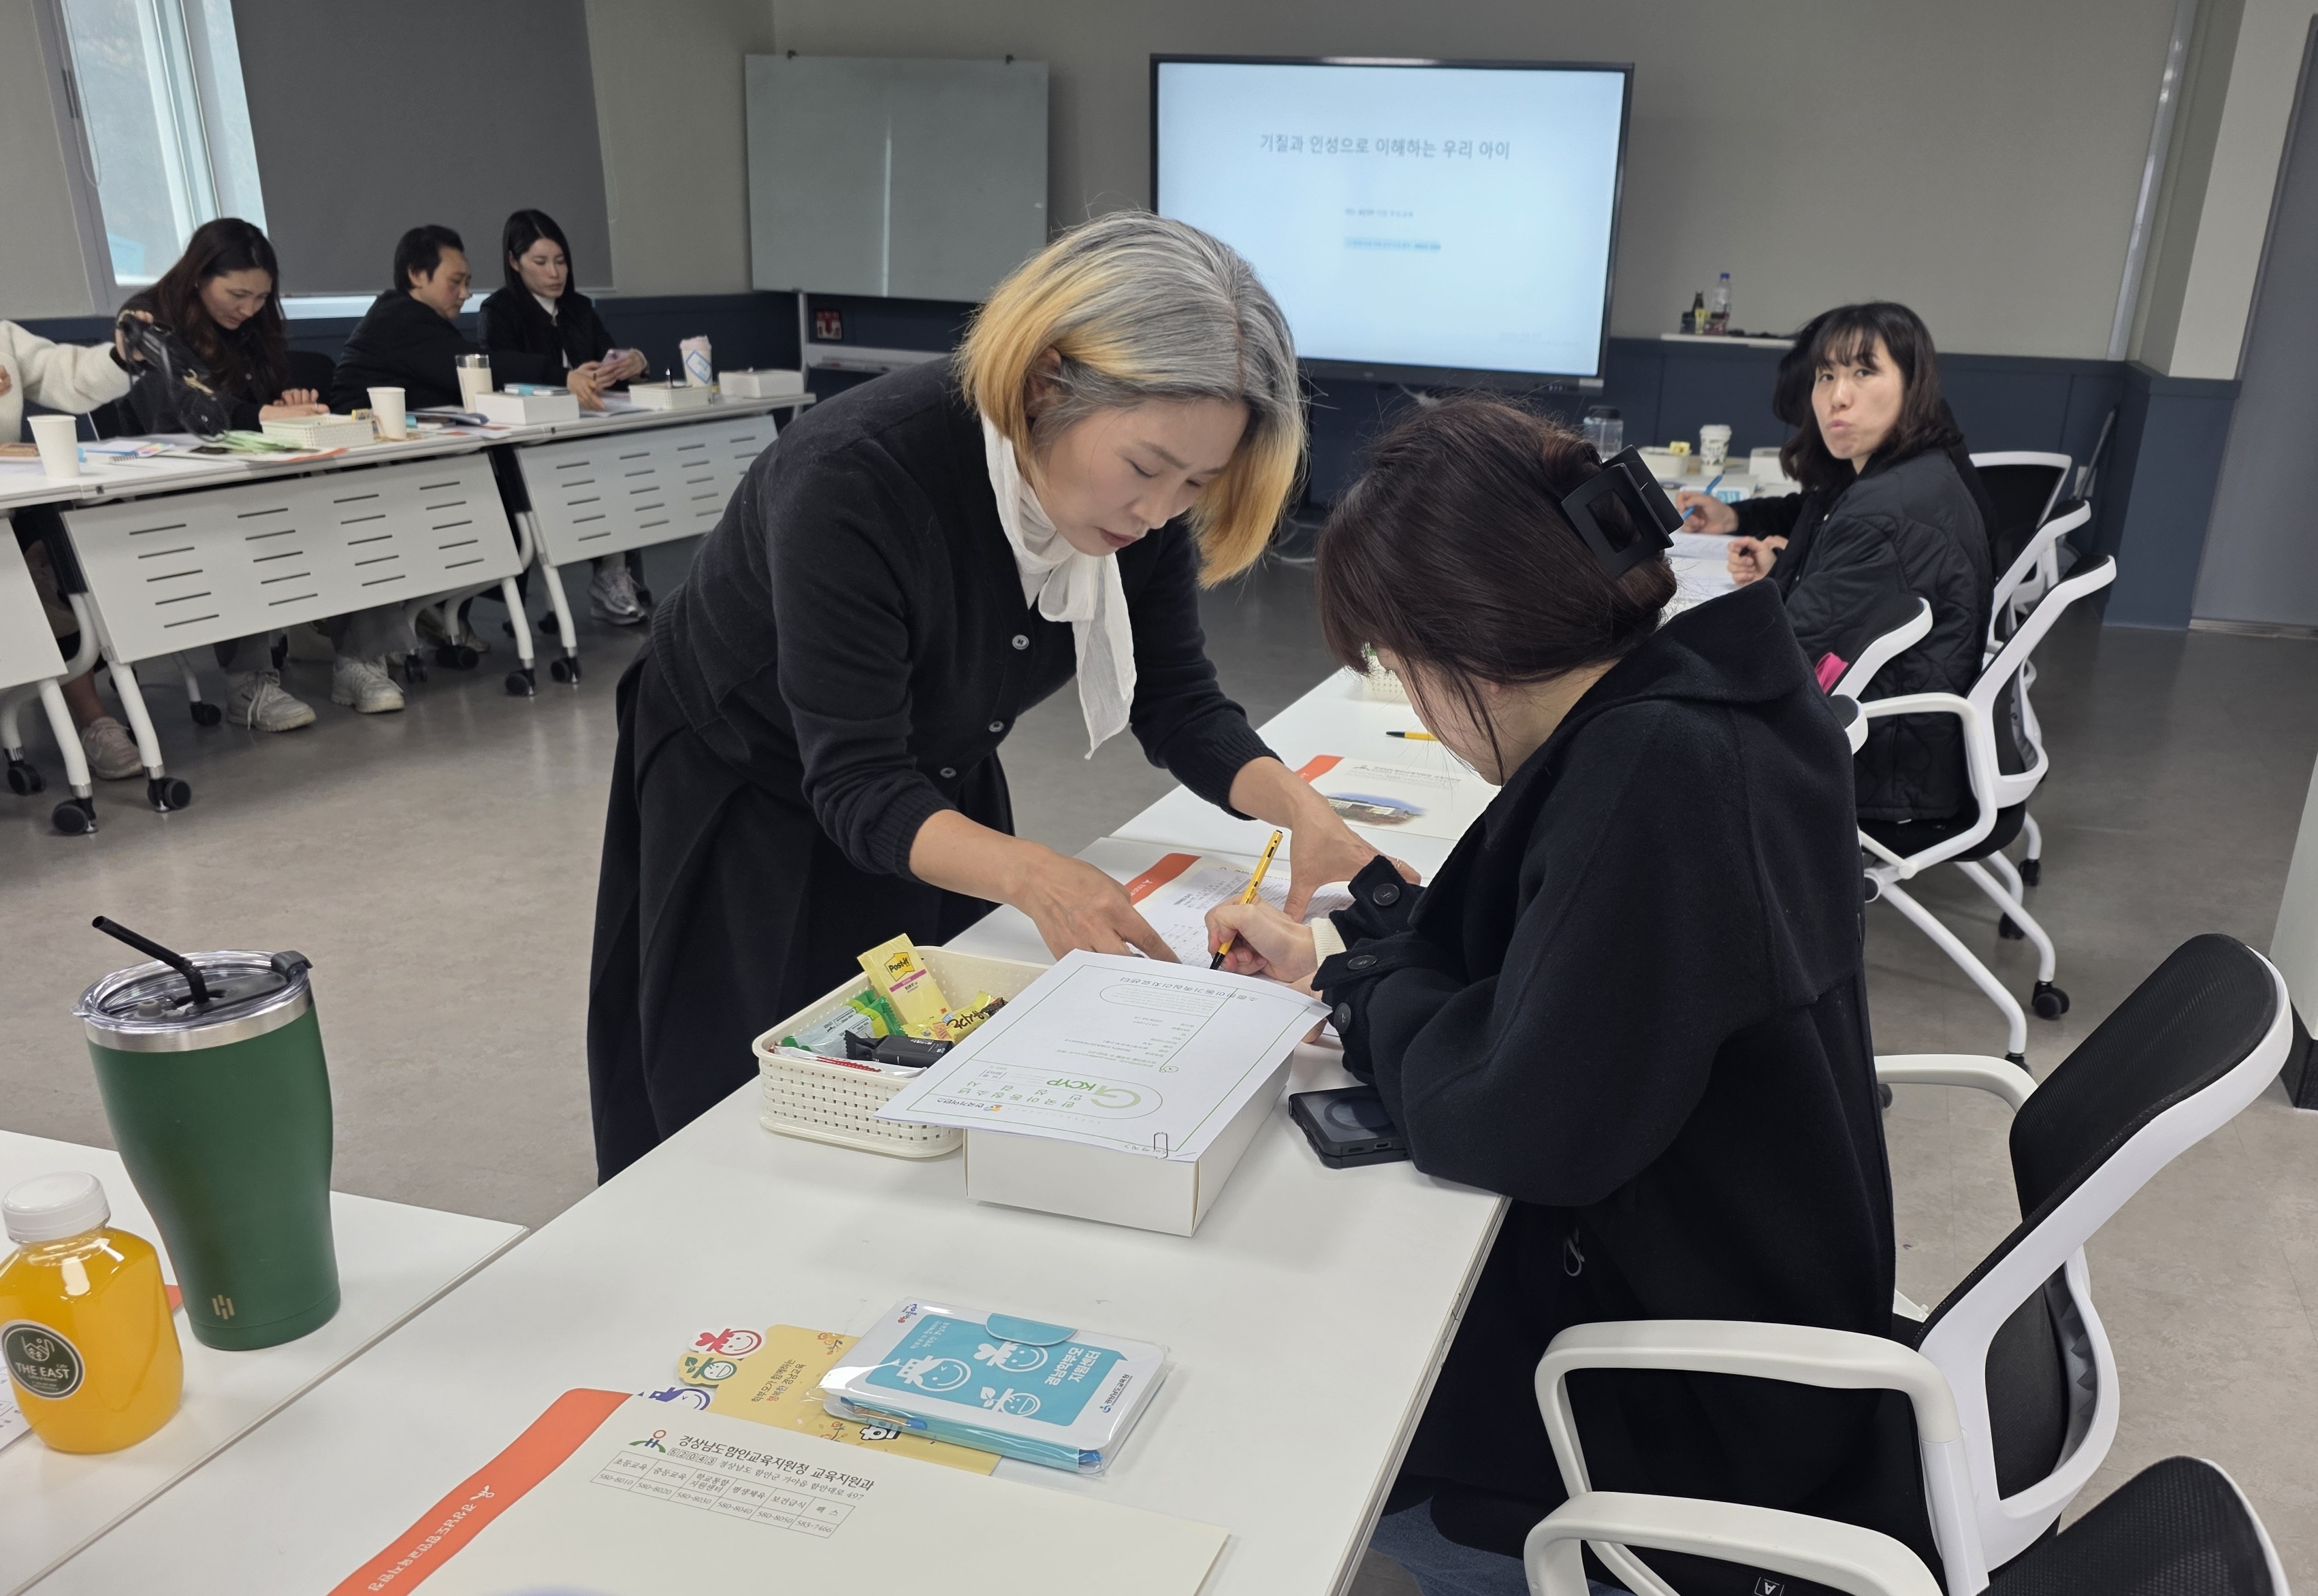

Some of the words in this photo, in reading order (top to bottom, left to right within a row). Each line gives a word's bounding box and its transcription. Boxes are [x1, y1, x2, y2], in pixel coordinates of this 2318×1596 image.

[1260, 133, 1303, 154] 기질과
[1309, 135, 1369, 155] 인성으로
[1375, 137, 1436, 158] 이해하는
[1443, 140, 1472, 159] 우리
[1479, 140, 1511, 161] 아이
[1046, 1078, 1097, 1091] KCYP
[15, 1362, 37, 1375] THE
[39, 1367, 70, 1379] EAST
[1044, 1347, 1084, 1386] 경남학부모
[1067, 1350, 1101, 1383] 지원센터
[751, 1380, 777, 1402] 학부모가
[770, 1358, 796, 1380] 함께하는
[767, 1385, 789, 1402] 행복한
[782, 1363, 807, 1385] 경남교육
[1104, 1373, 1130, 1404] 경상남도교육청
[613, 1457, 648, 1471] 초등교육
[679, 1435, 810, 1476] 경상남도함안교육지원청
[810, 1467, 875, 1491] 교육지원과
[598, 1473, 634, 1486] 580-8010
[653, 1467, 687, 1480] 중등교육
[668, 1448, 716, 1465] 52043
[718, 1460, 753, 1474] 경상남도
[754, 1469, 781, 1481] 함안군
[782, 1476, 808, 1488] 가야읍
[810, 1483, 845, 1497] 함안대로
[846, 1491, 865, 1501] 497
[637, 1482, 673, 1495] 580-8020
[689, 1480, 724, 1493] 지원센터
[732, 1486, 766, 1500] 평생체육
[677, 1491, 712, 1505] 580-8030
[770, 1495, 807, 1509] 보건급식
[718, 1501, 753, 1515] 580-8040
[757, 1511, 794, 1525] 580-8050
[796, 1520, 833, 1533] 583-7466
[368, 1503, 478, 1591] 경상남도함안교육지원청
